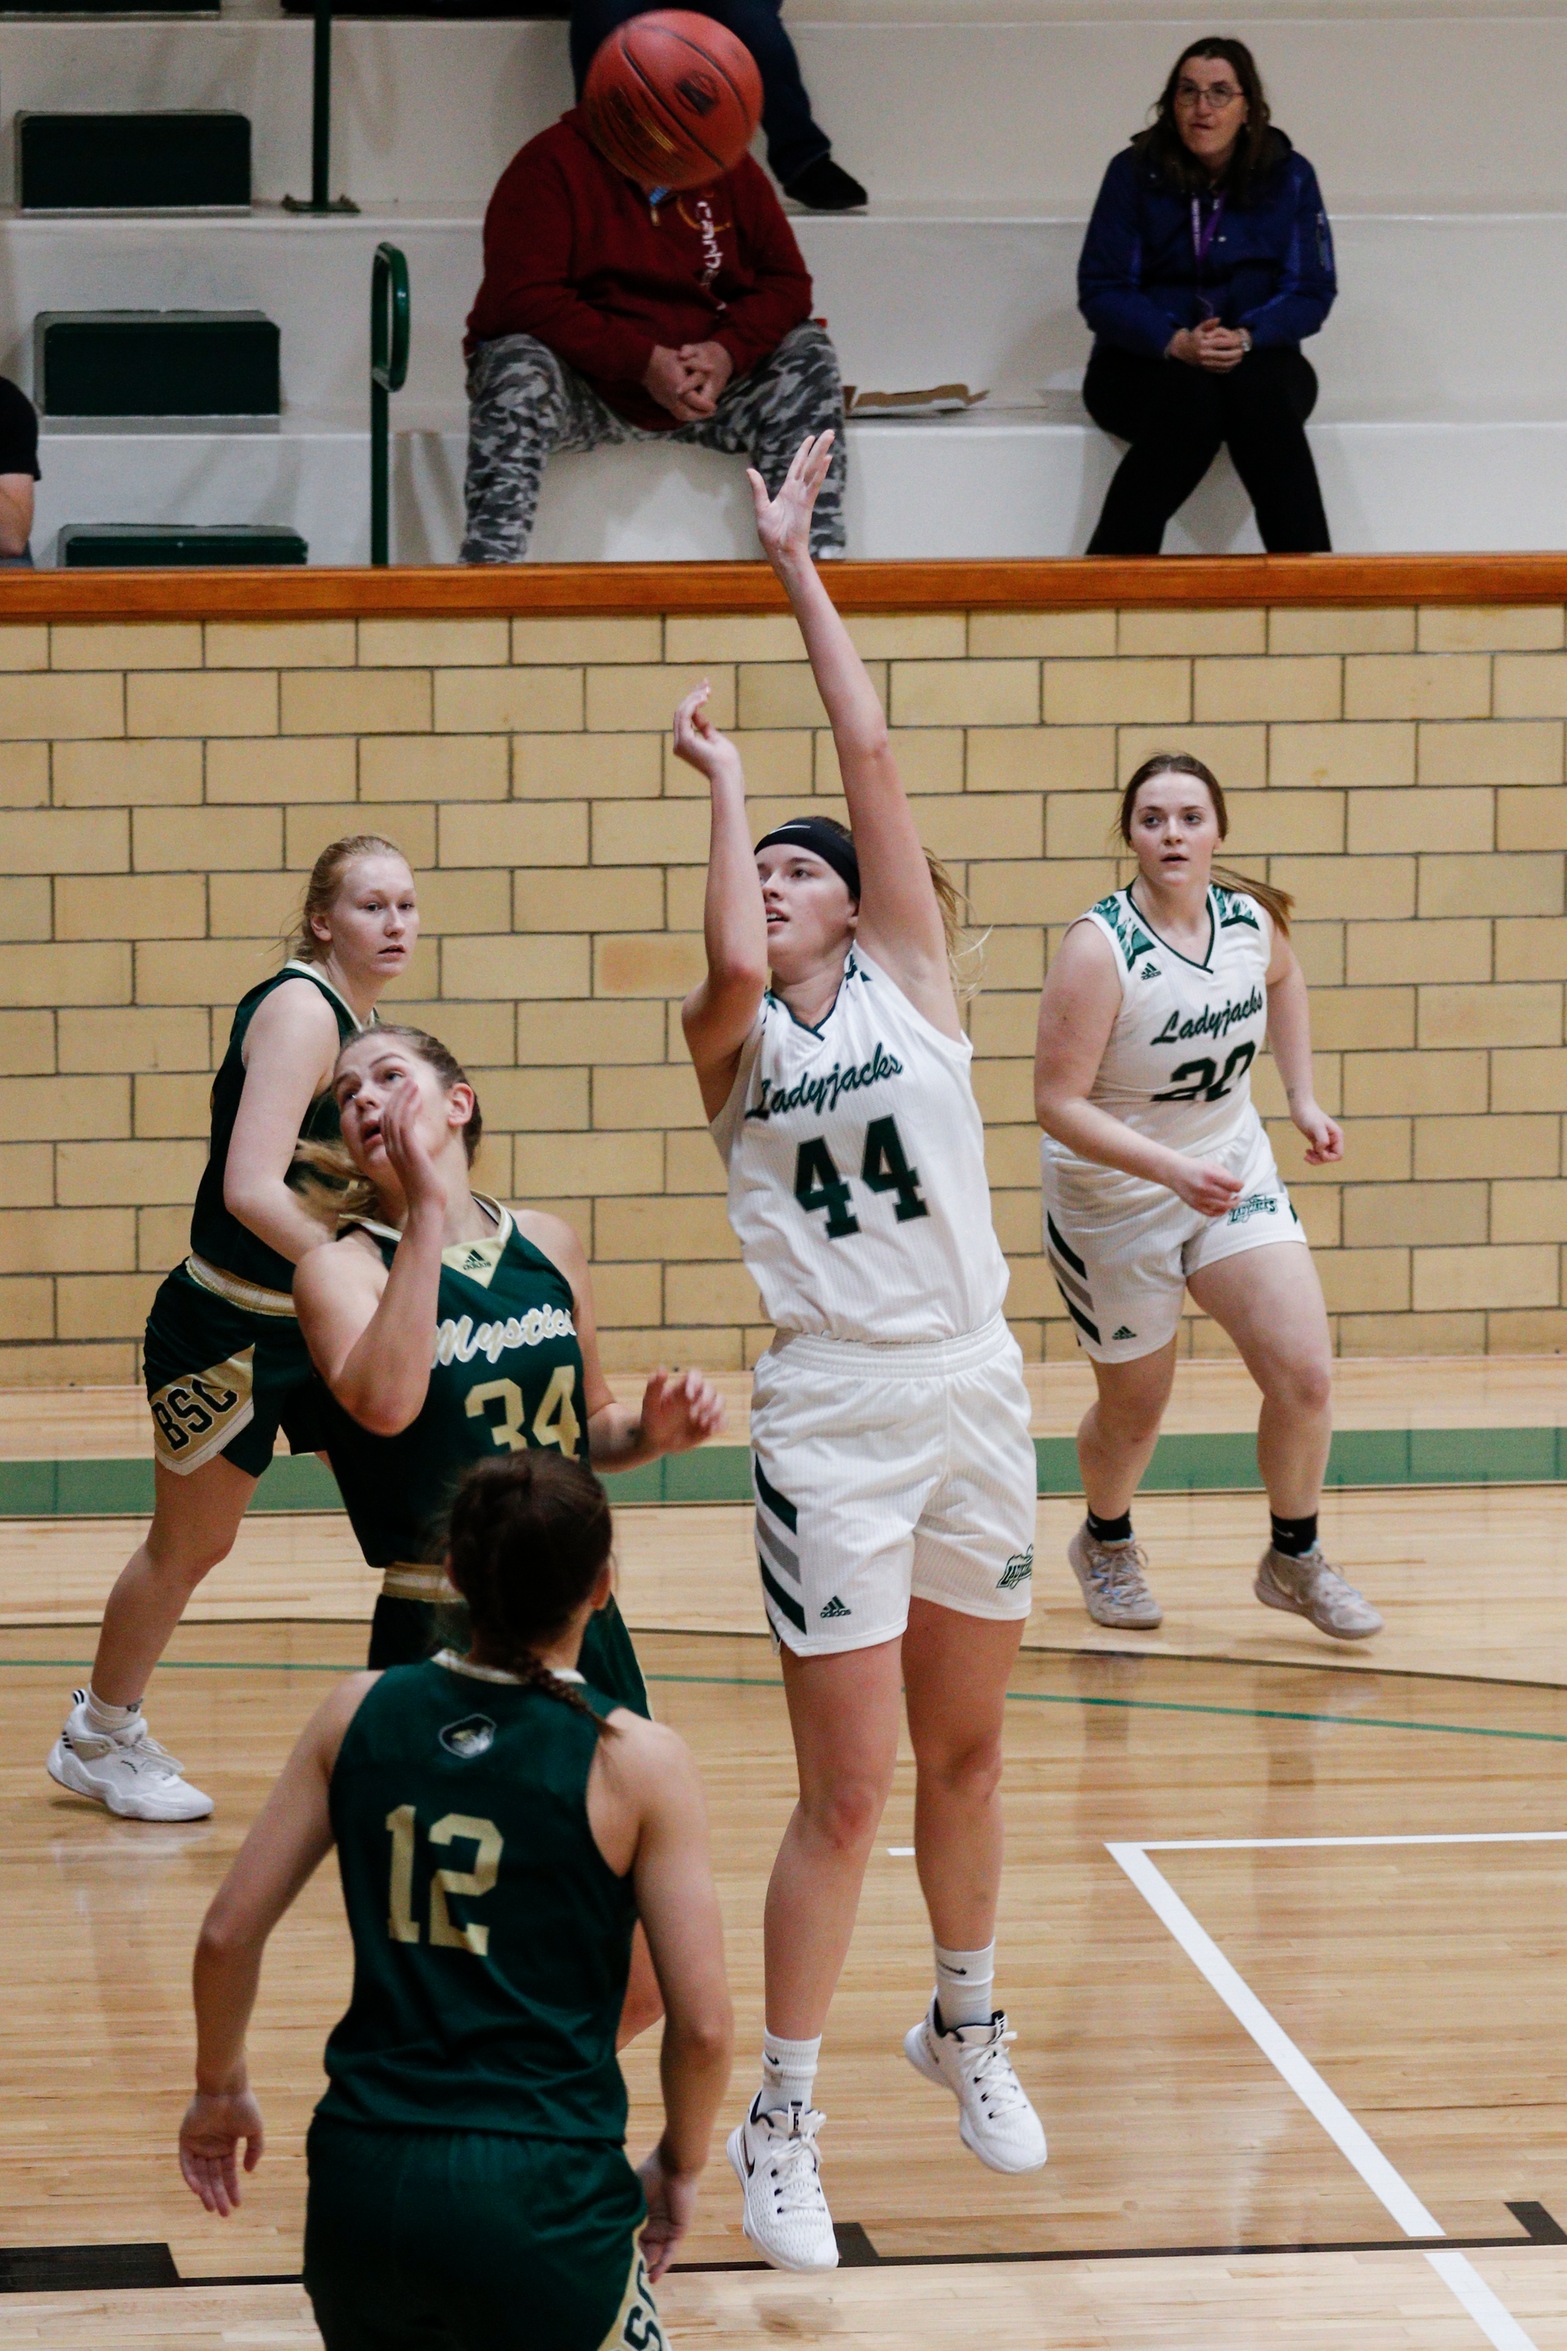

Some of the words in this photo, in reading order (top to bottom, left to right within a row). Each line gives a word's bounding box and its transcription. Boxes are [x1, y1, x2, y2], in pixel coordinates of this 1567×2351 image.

[1150, 984, 1263, 1046] Ladyjacks
[744, 1042, 903, 1121] Ladyjacks
[1150, 1040, 1257, 1103] 20
[794, 1112, 931, 1242] 44
[150, 1378, 239, 1452] BSC
[464, 1365, 582, 1462] 34
[386, 1804, 504, 1957] 12
